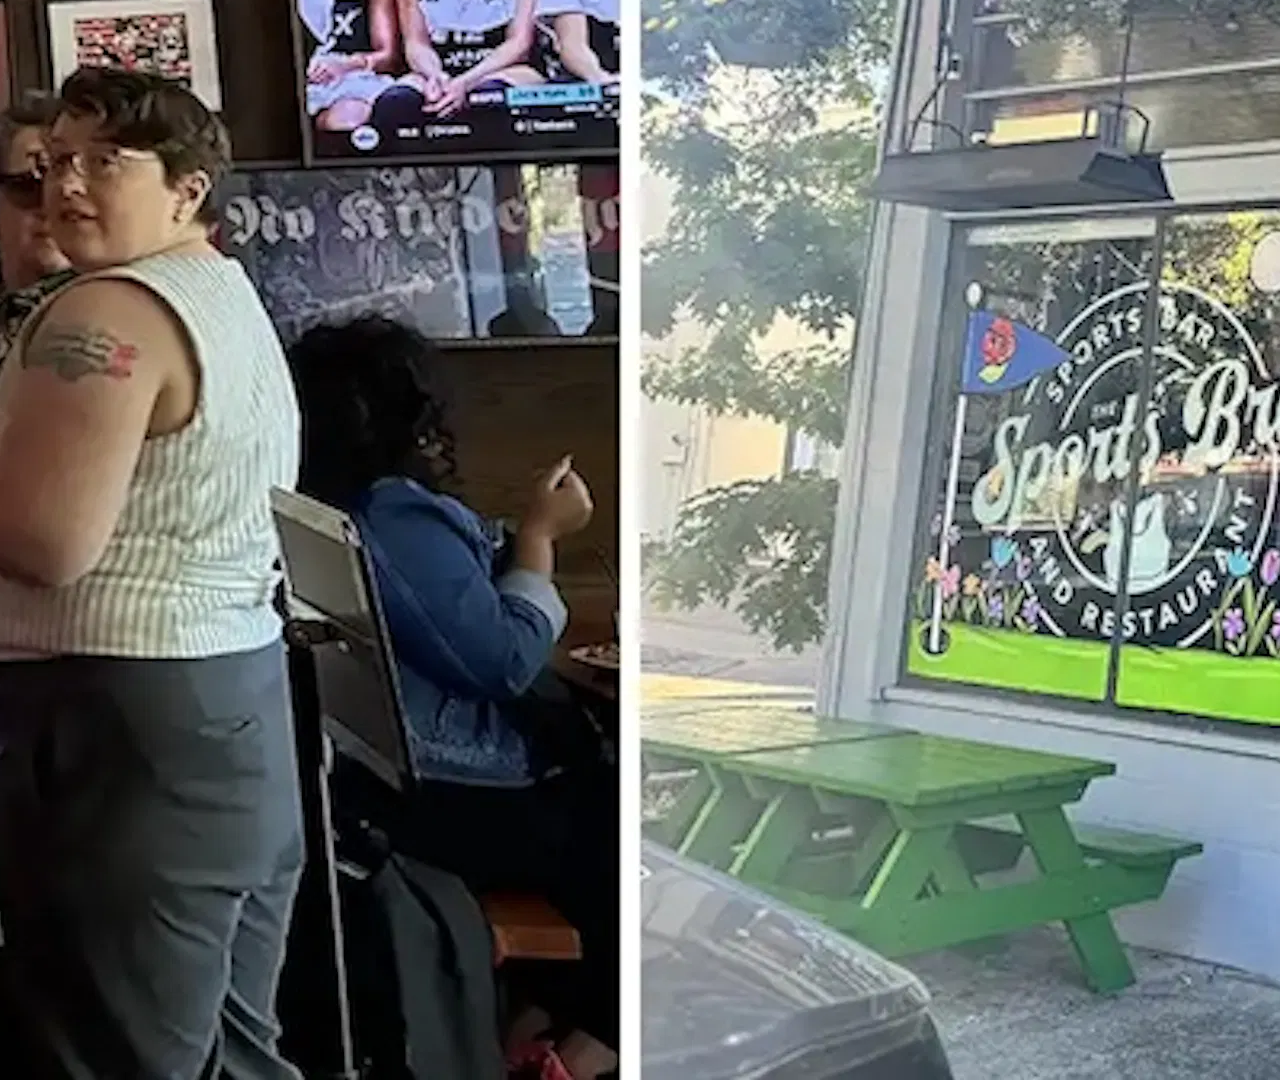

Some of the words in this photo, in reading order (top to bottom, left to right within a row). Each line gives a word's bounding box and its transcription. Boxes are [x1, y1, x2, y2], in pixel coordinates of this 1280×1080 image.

[1045, 306, 1144, 405] SPORTS
[1158, 295, 1215, 350] BAR
[972, 392, 1162, 537] Sports
[1029, 536, 1074, 606] AND
